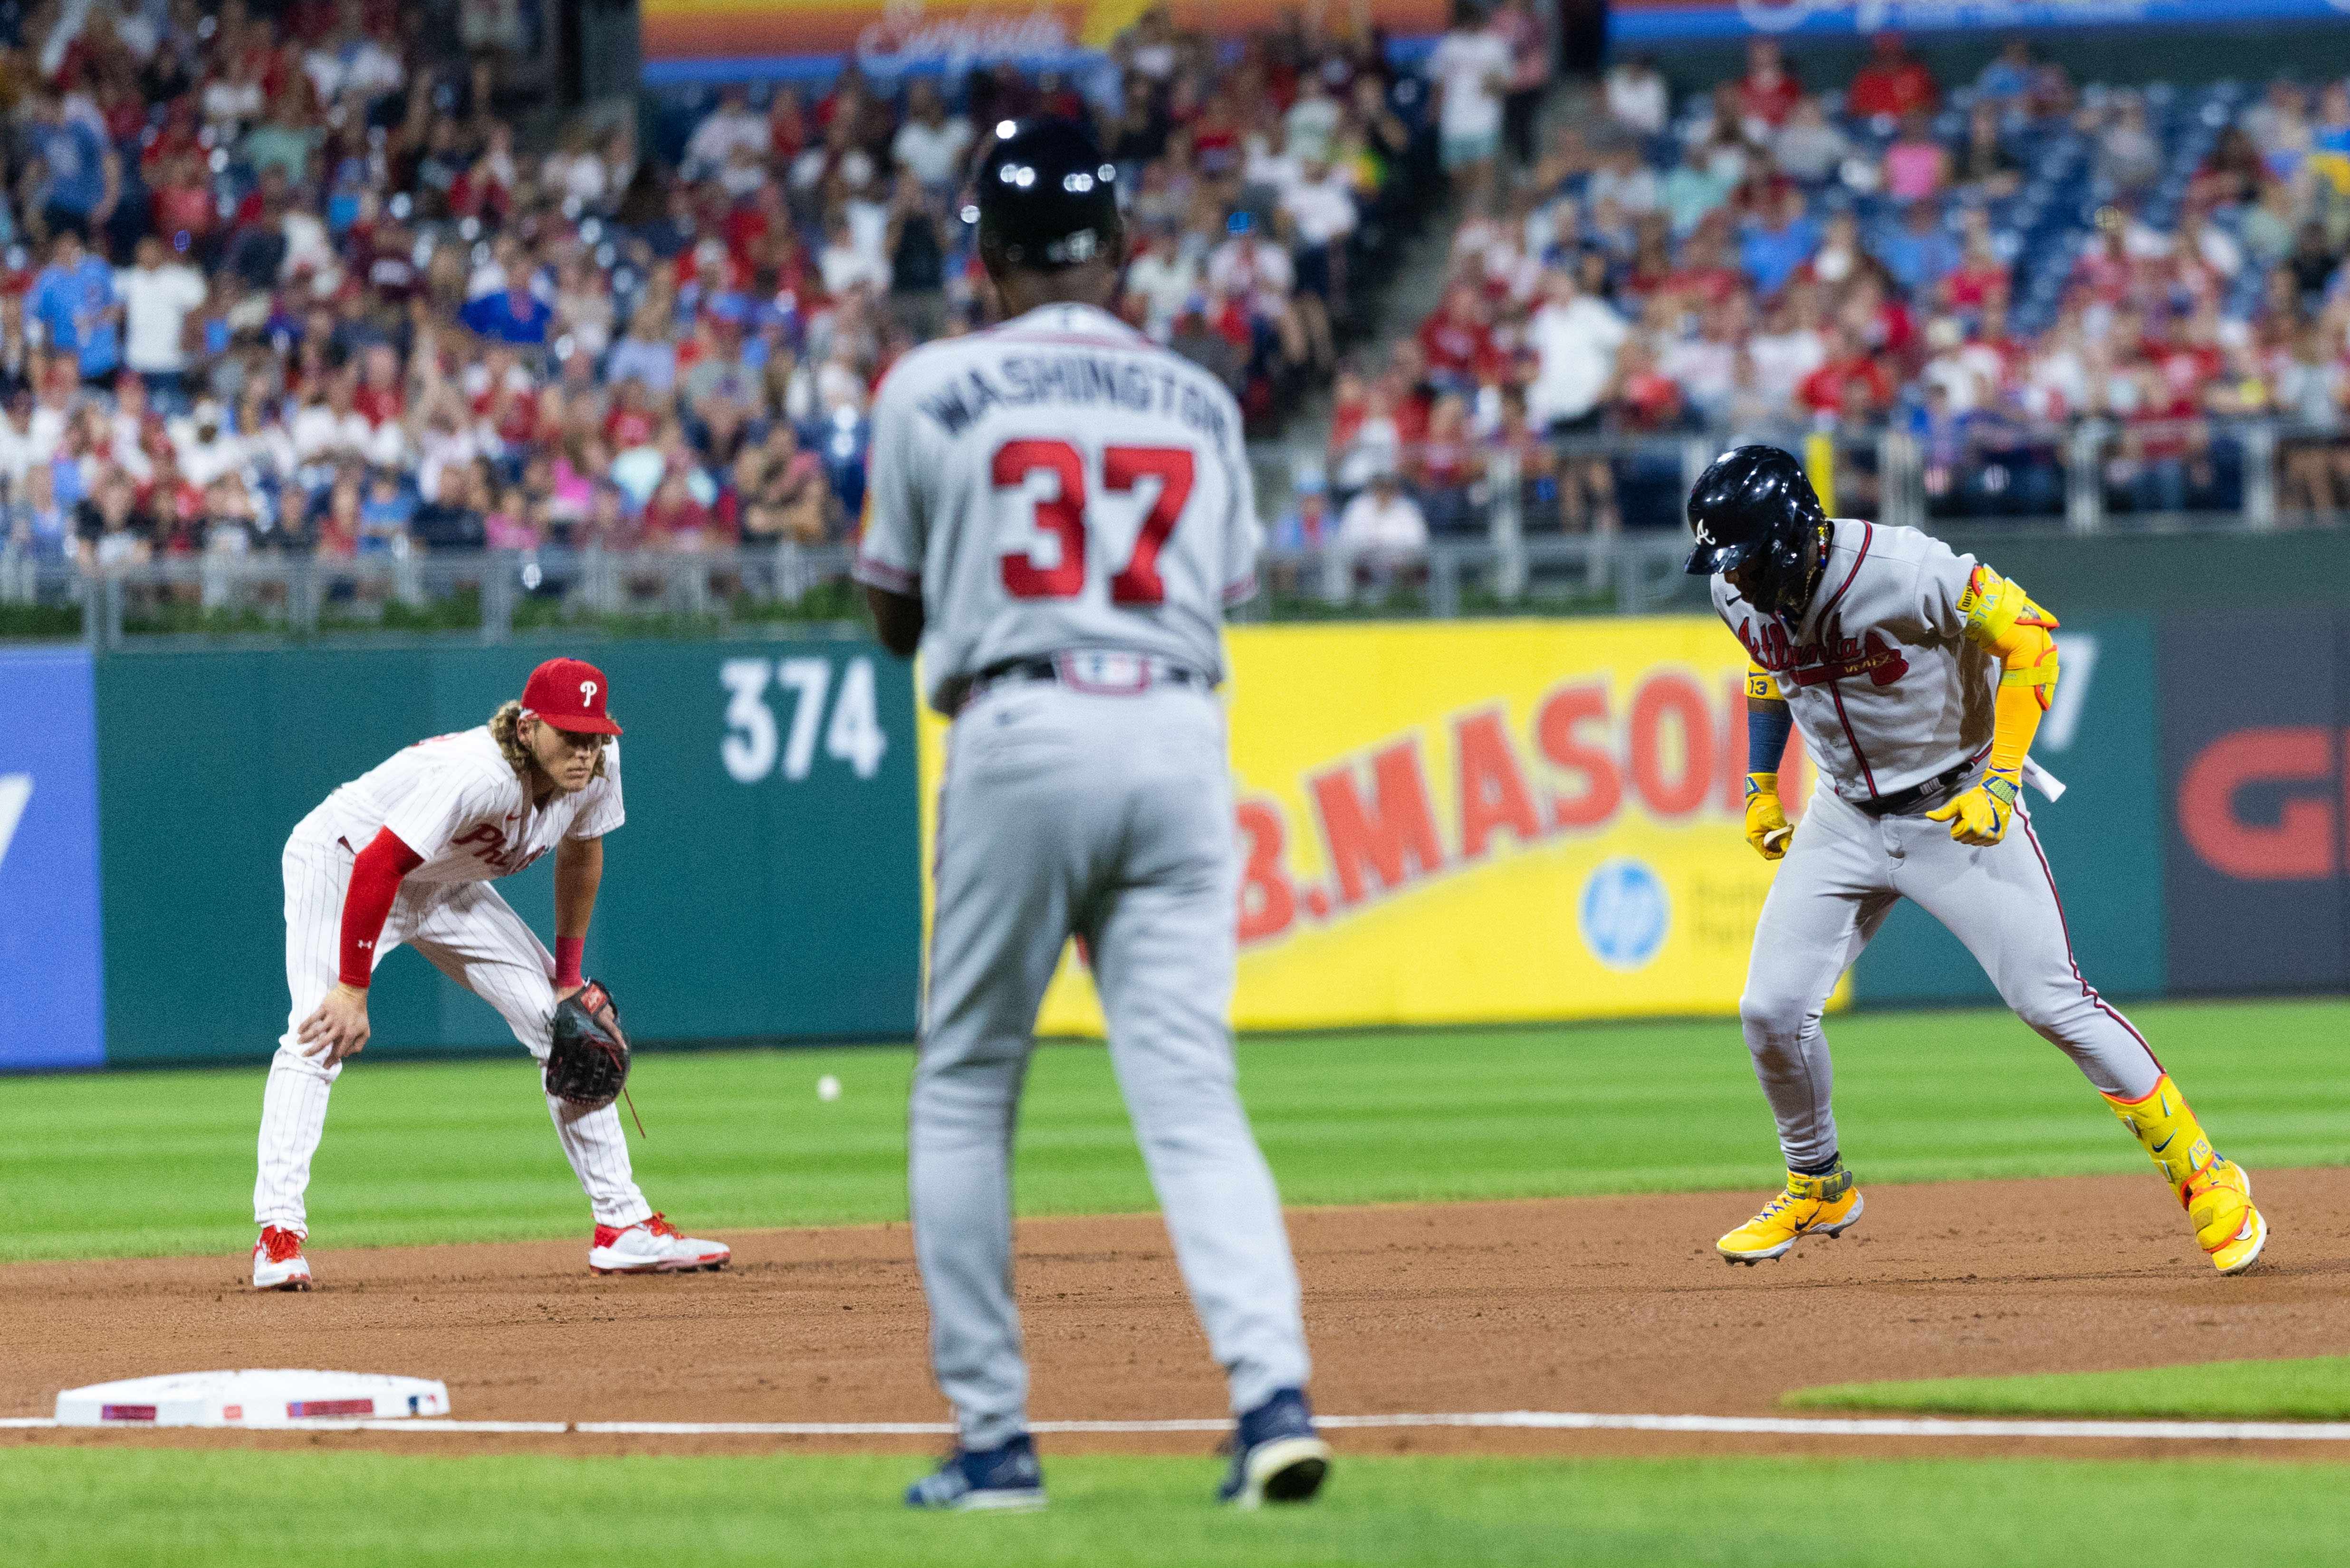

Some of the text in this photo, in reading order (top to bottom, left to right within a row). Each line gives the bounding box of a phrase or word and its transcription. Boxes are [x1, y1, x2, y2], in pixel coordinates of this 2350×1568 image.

[918, 352, 1226, 449] WASHINGTON
[993, 440, 1194, 606] 37
[1695, 518, 1716, 545] A
[1738, 611, 1861, 671] Atlanta
[580, 680, 597, 708] P
[1750, 679, 1767, 696] 13
[720, 658, 889, 782] 374
[2192, 1139, 2208, 1158] 13
